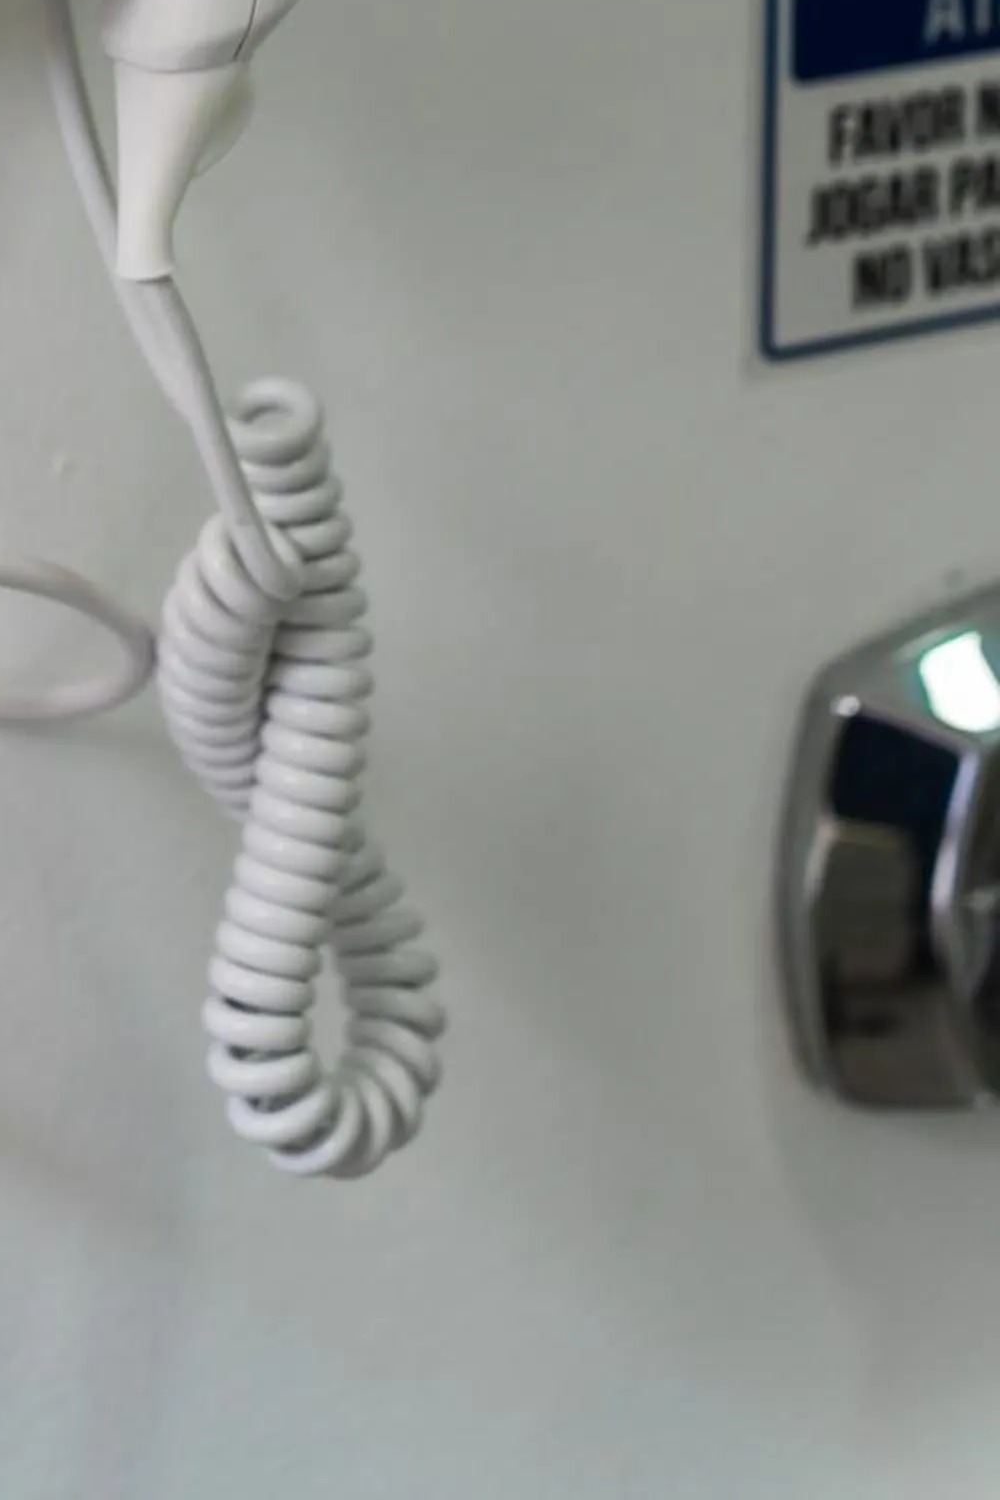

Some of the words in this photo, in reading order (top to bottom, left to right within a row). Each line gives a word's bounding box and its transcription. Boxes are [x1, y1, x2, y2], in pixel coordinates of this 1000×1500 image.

[827, 85, 966, 168] FAVOR
[805, 164, 940, 248] JOGAR
[850, 240, 914, 314] NO
